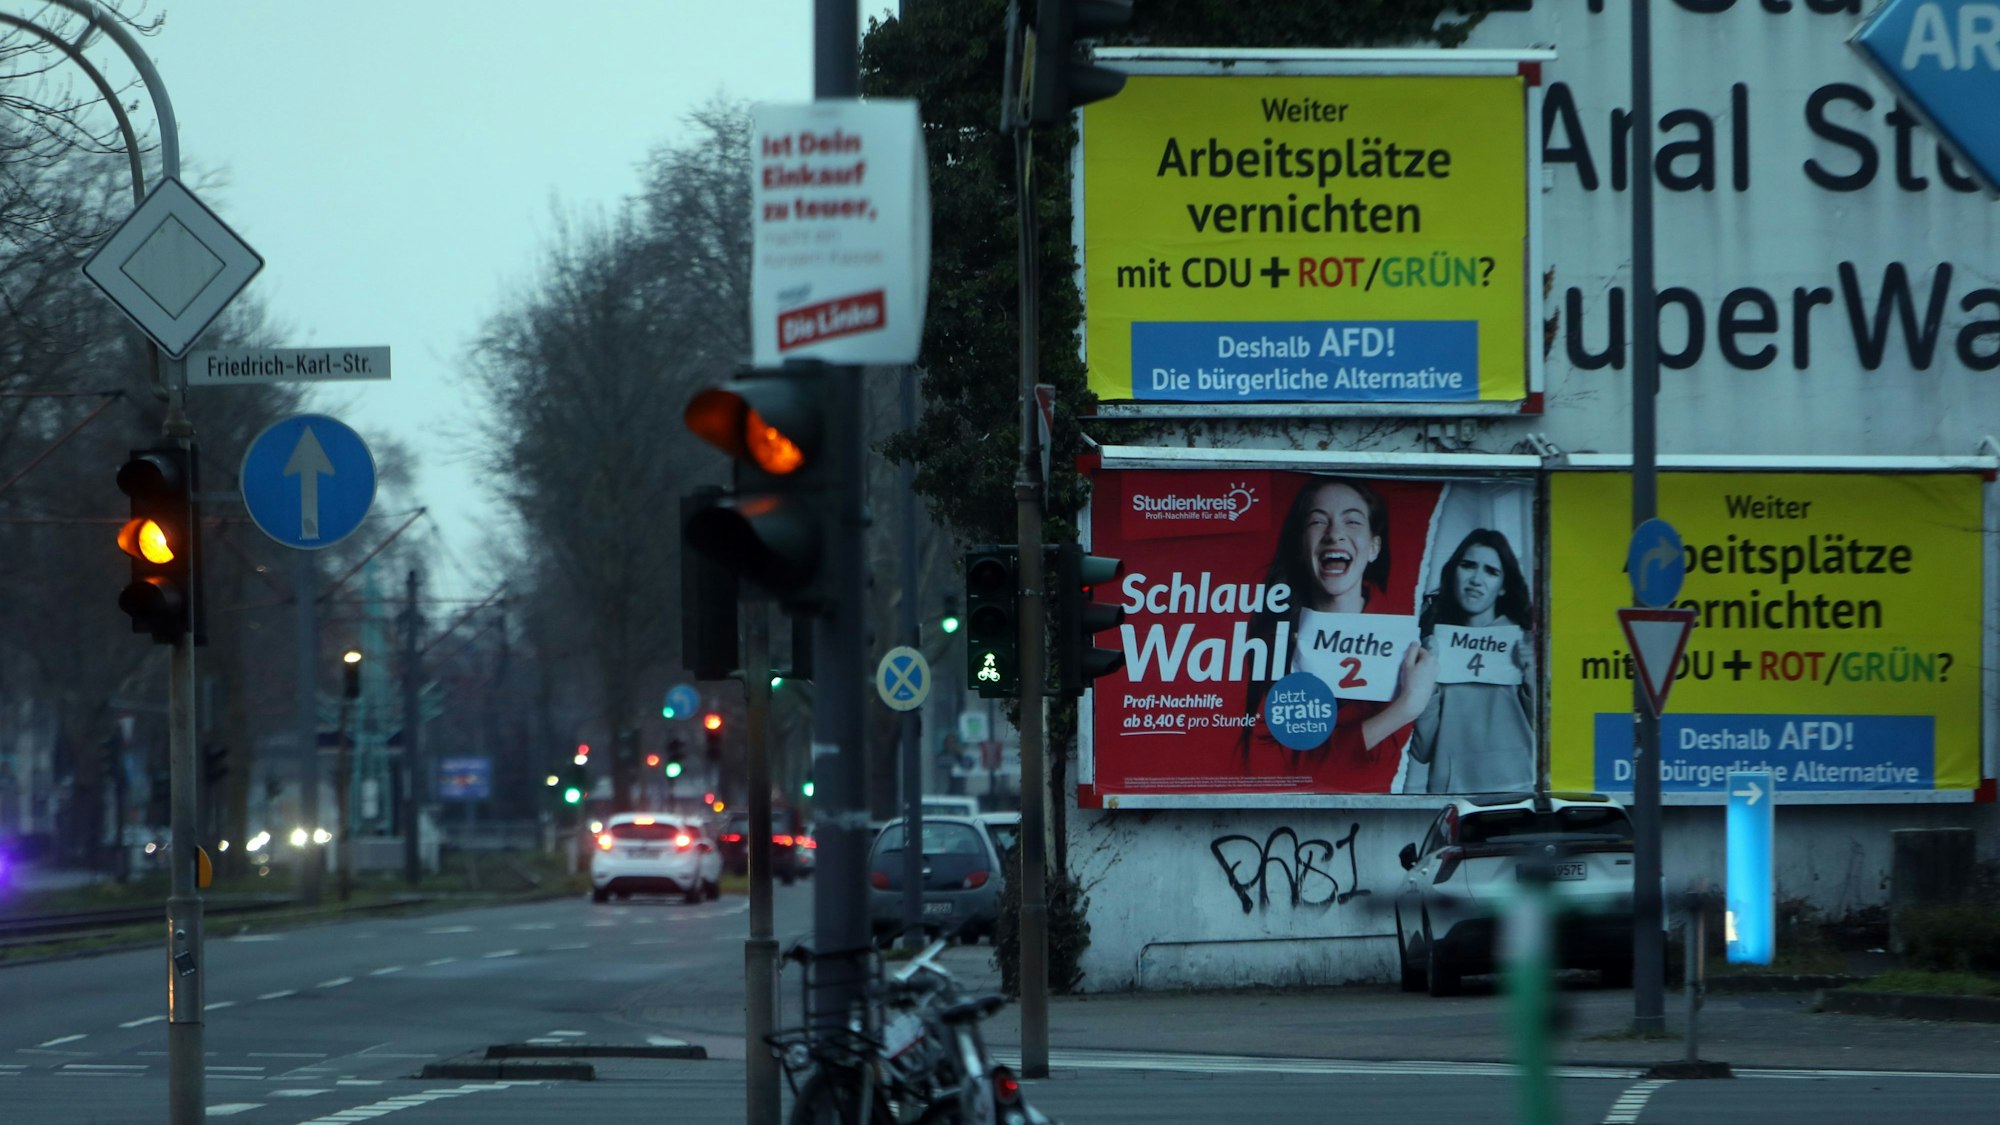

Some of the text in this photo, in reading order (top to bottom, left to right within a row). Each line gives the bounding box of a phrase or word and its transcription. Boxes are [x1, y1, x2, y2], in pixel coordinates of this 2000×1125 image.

[1902, 3, 2000, 71] AR
[1262, 98, 1349, 122] Weiter
[761, 130, 862, 157] Ist Dein
[1542, 82, 1748, 192] Aral
[762, 161, 866, 189] Einkauf
[1157, 138, 1451, 187] Arbeitsplätze
[762, 198, 878, 222] zu teuer,
[1187, 194, 1421, 233] vernichten
[1117, 259, 1171, 288] mit
[1181, 258, 1252, 288] CDU
[1299, 251, 1495, 291] ROT/GRÜN?
[783, 303, 879, 344] Die Linke
[1219, 328, 1395, 358] Deshalb AFD!
[208, 353, 372, 377] Friedrich-Karl-Str.
[1152, 368, 1462, 395] Die bürgerliche Alternative
[1132, 494, 1237, 511] Studienkreis
[1145, 511, 1227, 520] Profi-Nachhilfe für alle
[1725, 495, 1811, 519] Weiter
[1622, 535, 1912, 584] eitsplätze
[1121, 572, 1291, 614] Schlaue
[1667, 590, 1882, 630] ernichten
[1120, 621, 1290, 682] Wahl
[1313, 629, 1393, 657] Mathe
[1451, 632, 1507, 653] Mathe
[1338, 657, 1367, 689] 2
[1466, 653, 1485, 677] 4
[1581, 650, 1634, 680] mit
[1760, 646, 1953, 686] ROT/GRÜN?
[1123, 694, 1223, 709] Profi-Nachhilfe
[1272, 689, 1306, 704] Jetzt
[1123, 714, 1141, 728] ab
[1187, 717, 1209, 730] pro
[1272, 699, 1332, 725] gratis
[1286, 721, 1327, 734] testen
[1680, 722, 1854, 751] Deshalb AFD!
[1793, 760, 1919, 783] Alternative
